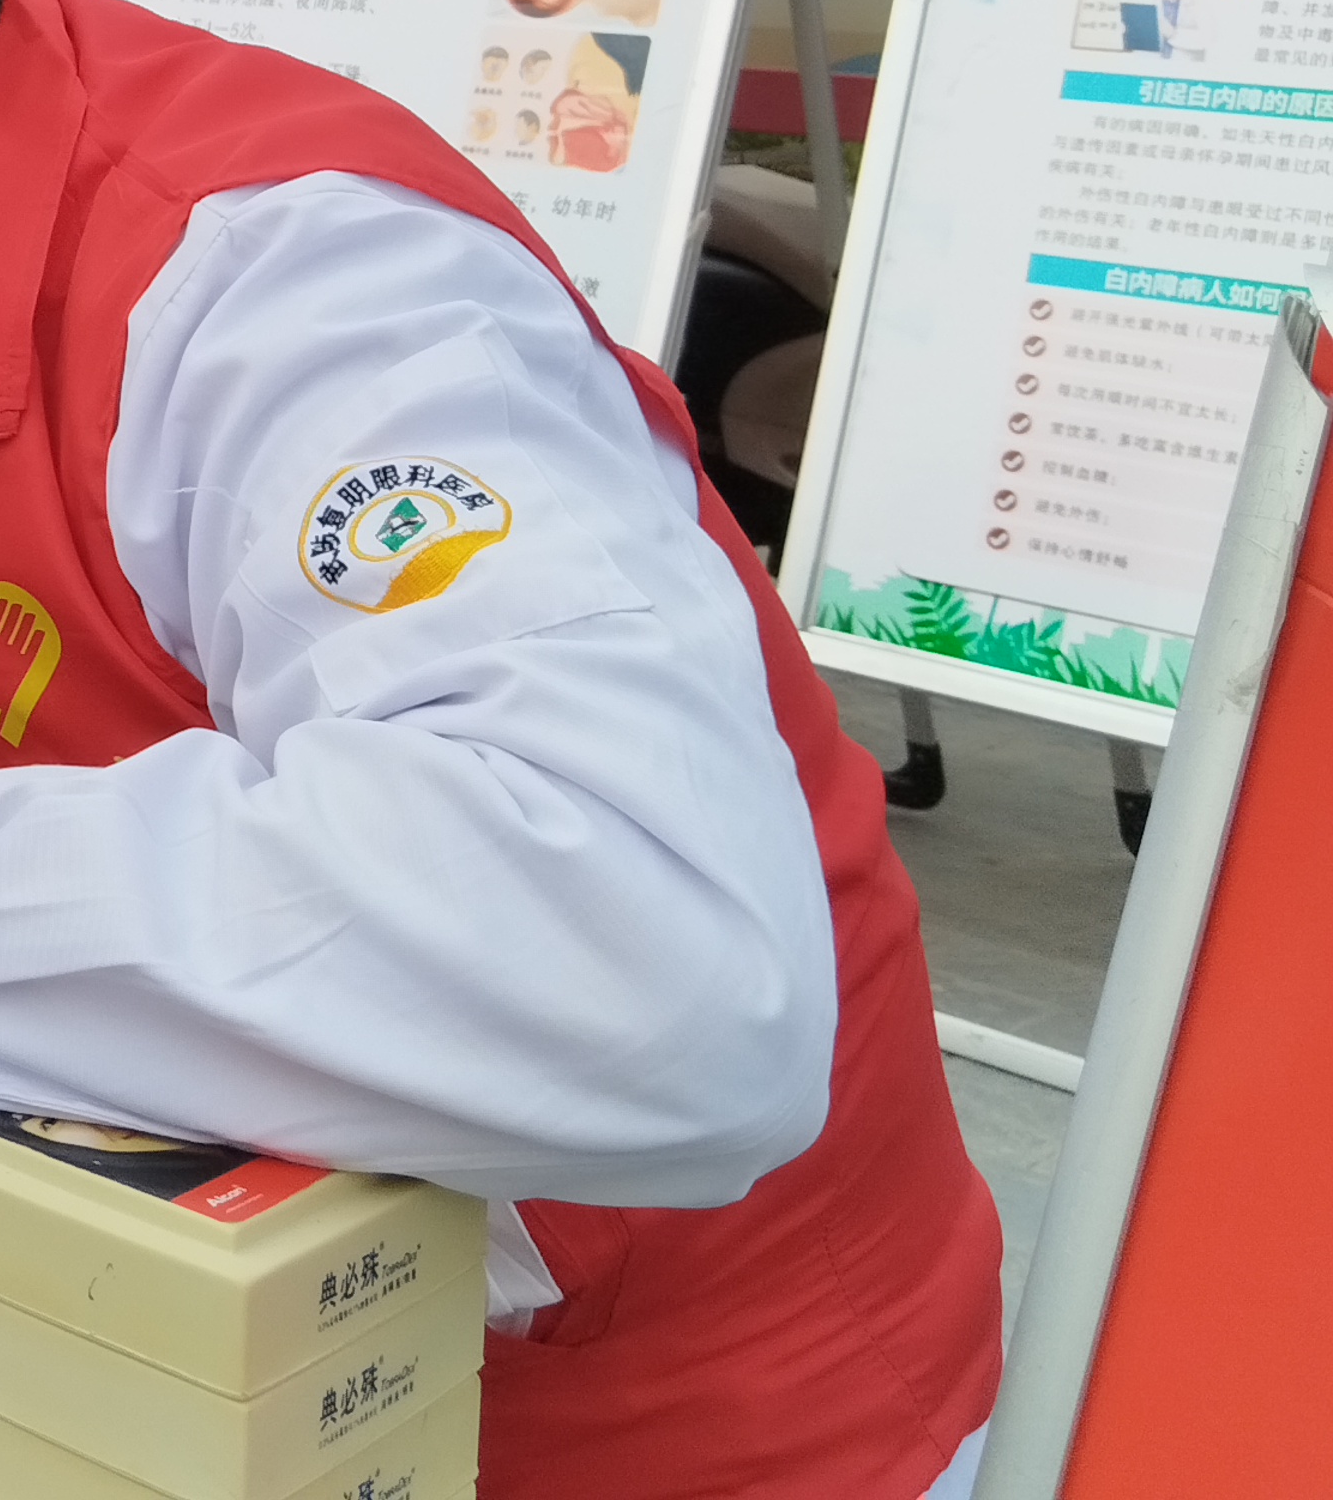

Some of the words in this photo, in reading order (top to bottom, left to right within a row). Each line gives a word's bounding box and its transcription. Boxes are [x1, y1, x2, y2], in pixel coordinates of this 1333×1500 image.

[1254, 46, 1333, 67] 最常见的
[1139, 80, 1333, 118] 引起白内障的原因
[319, 1247, 380, 1315] 典必殊
[319, 1362, 379, 1432] 典必殊
